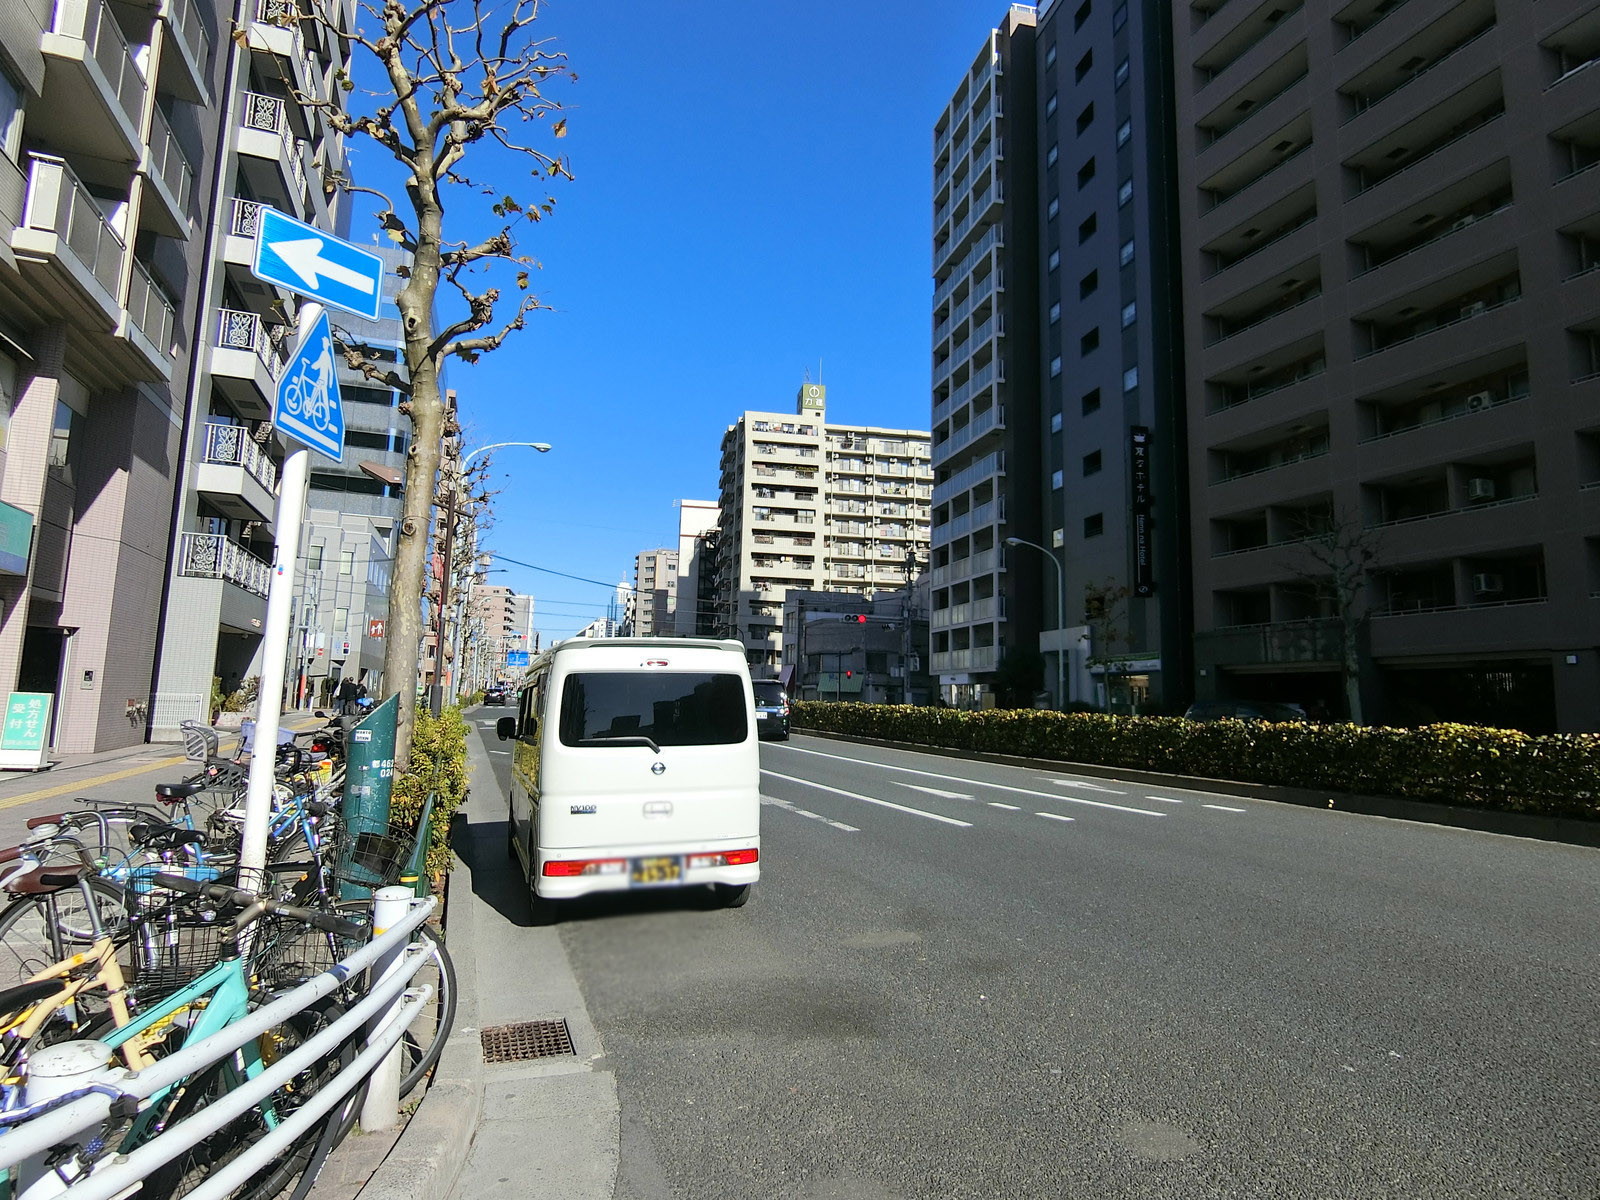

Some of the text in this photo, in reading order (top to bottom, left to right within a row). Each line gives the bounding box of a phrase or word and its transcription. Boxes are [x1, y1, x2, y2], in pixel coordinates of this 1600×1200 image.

[10, 703, 26, 729] 受付
[24, 699, 42, 738] 処方せん
